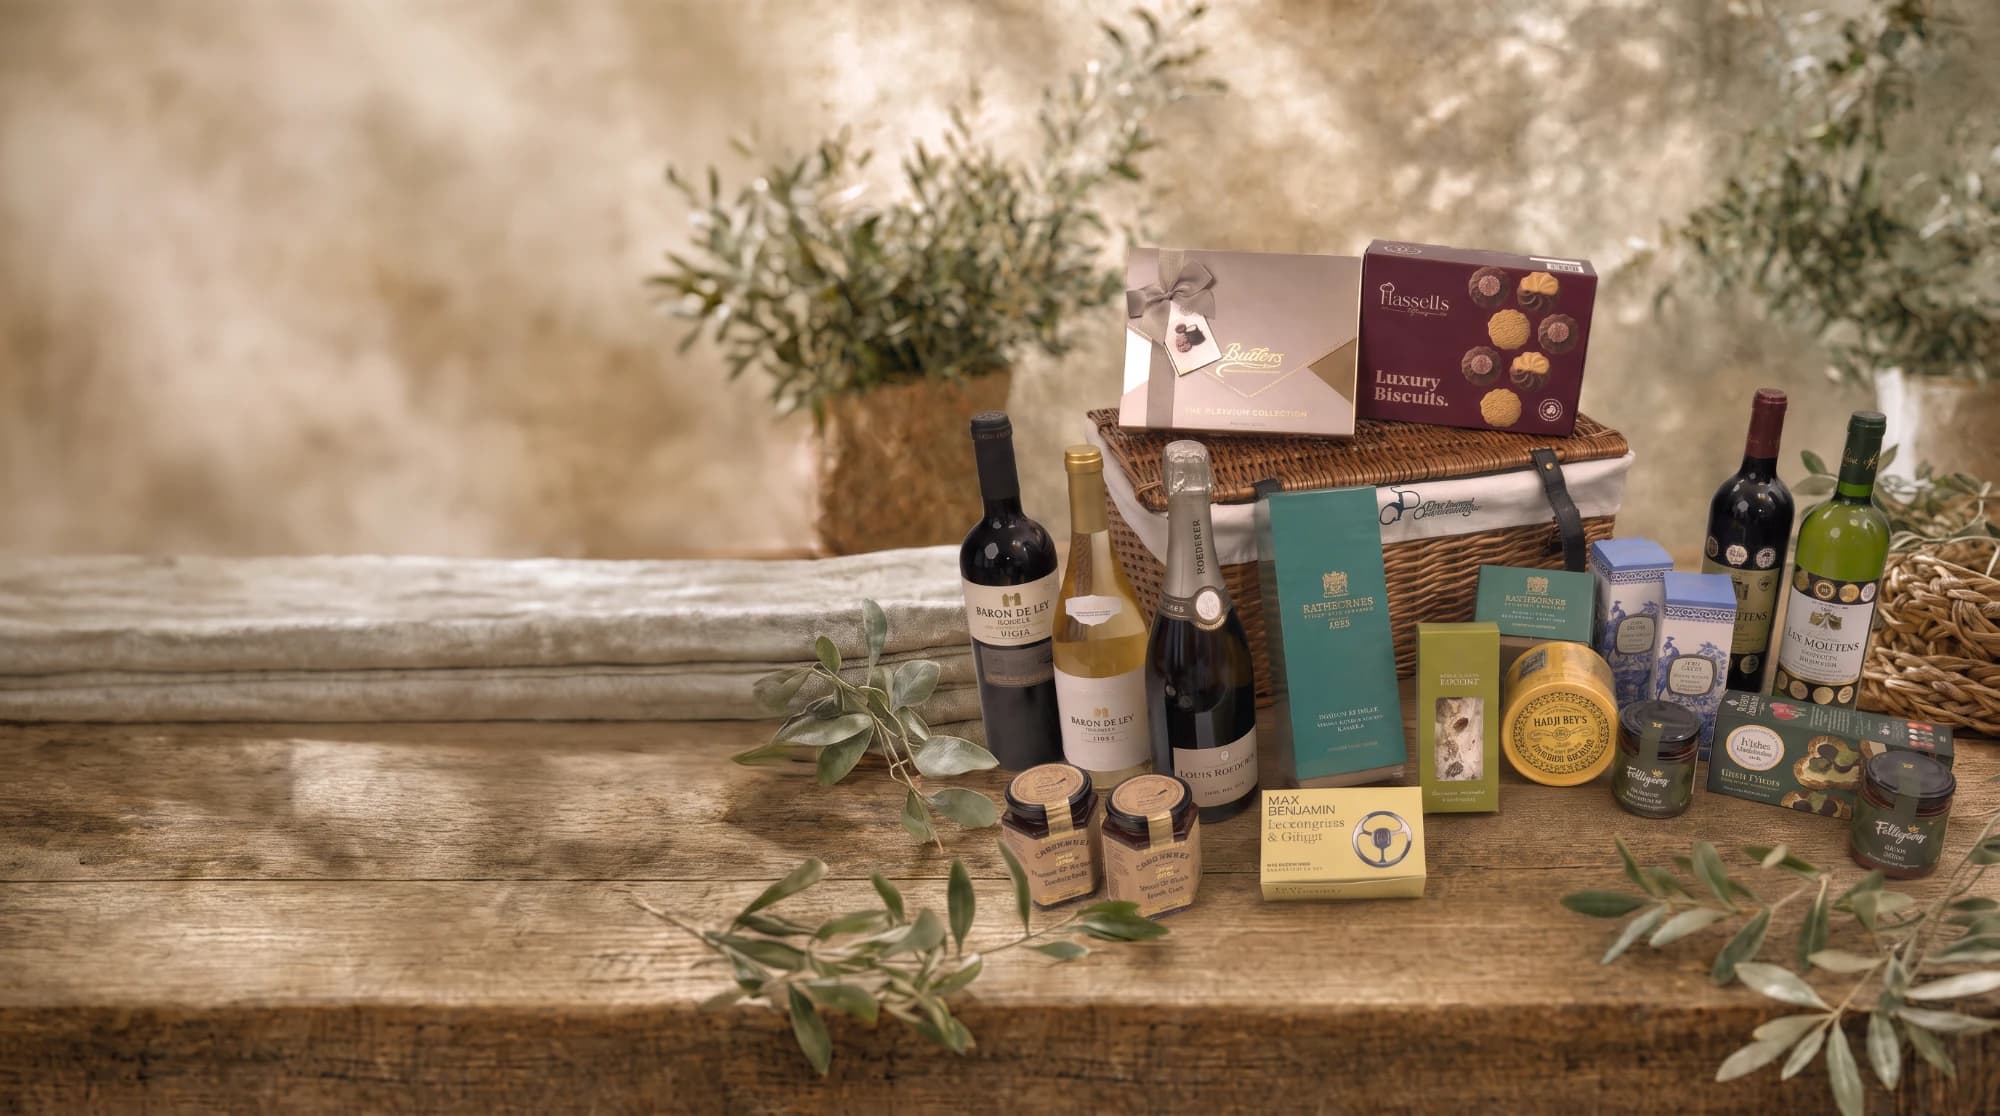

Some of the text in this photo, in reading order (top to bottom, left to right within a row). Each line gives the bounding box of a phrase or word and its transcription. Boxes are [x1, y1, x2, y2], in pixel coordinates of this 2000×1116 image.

[1380, 282, 1449, 311] Hassells
[1376, 370, 1441, 391] Luxury
[1374, 387, 1449, 407] Biscuits.
[1193, 519, 1206, 575] ROEDERER
[976, 600, 1049, 618] BARON DE LEY
[1071, 713, 1135, 728] BARON DE LEY
[1534, 715, 1588, 727] HADJI BEY'S
[1268, 795, 1300, 806] MAX
[1268, 805, 1336, 817] BENJAMIN
